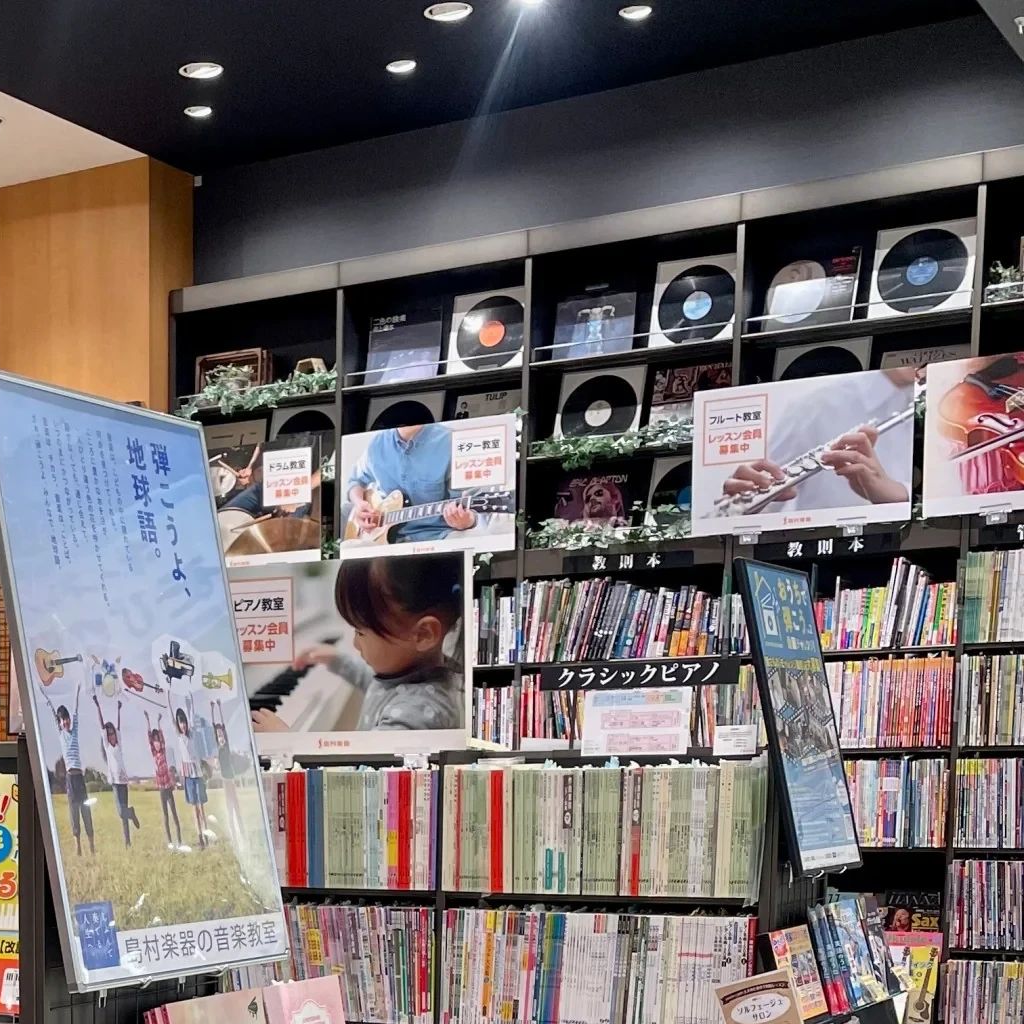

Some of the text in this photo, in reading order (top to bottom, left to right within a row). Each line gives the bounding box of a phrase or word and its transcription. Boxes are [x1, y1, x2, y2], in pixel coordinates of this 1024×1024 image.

[709, 411, 762, 425] フルート教室
[708, 429, 762, 444] レッスン会員
[456, 438, 501, 453] ギター教室
[718, 443, 750, 455] 募集中
[268, 459, 307, 473] ドラム教室
[455, 457, 502, 470] レッスン会員
[266, 475, 309, 488] レッスン会員
[464, 469, 492, 481] 募集中
[125, 436, 162, 559] 地球語。
[275, 488, 299, 498] 募集中
[149, 441, 193, 598] 弾こうよ、
[786, 536, 864, 558] 教則本
[592, 553, 662, 570] 教則本
[234, 597, 285, 613] ピアノ教室
[242, 639, 276, 653] 募集中
[557, 661, 721, 688] クラシックピアノ
[911, 913, 940, 928] Sax
[124, 919, 280, 965] 島村楽器の音楽教室
[736, 1000, 784, 1016] ソルフェージュ
[752, 1010, 773, 1021] サロン
